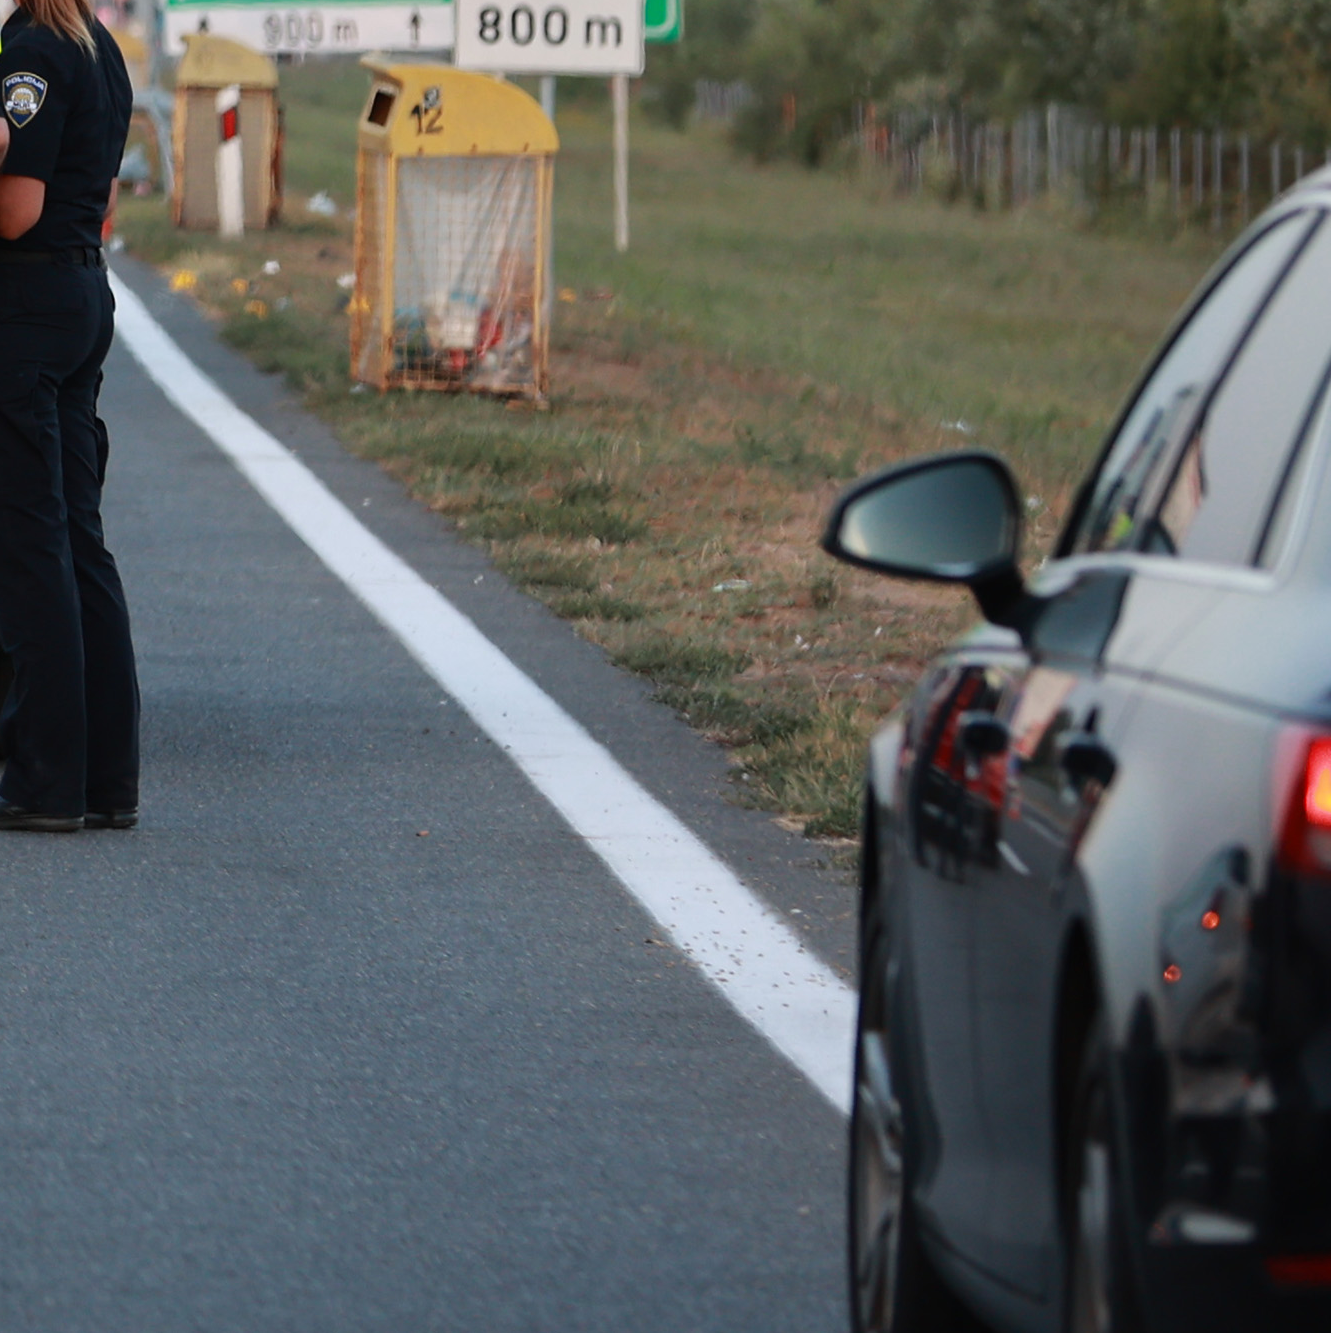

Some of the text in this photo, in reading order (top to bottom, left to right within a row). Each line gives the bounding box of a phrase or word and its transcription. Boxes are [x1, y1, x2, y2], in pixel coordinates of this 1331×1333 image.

[263, 13, 359, 48] 900 m
[478, 6, 623, 47] 800 m
